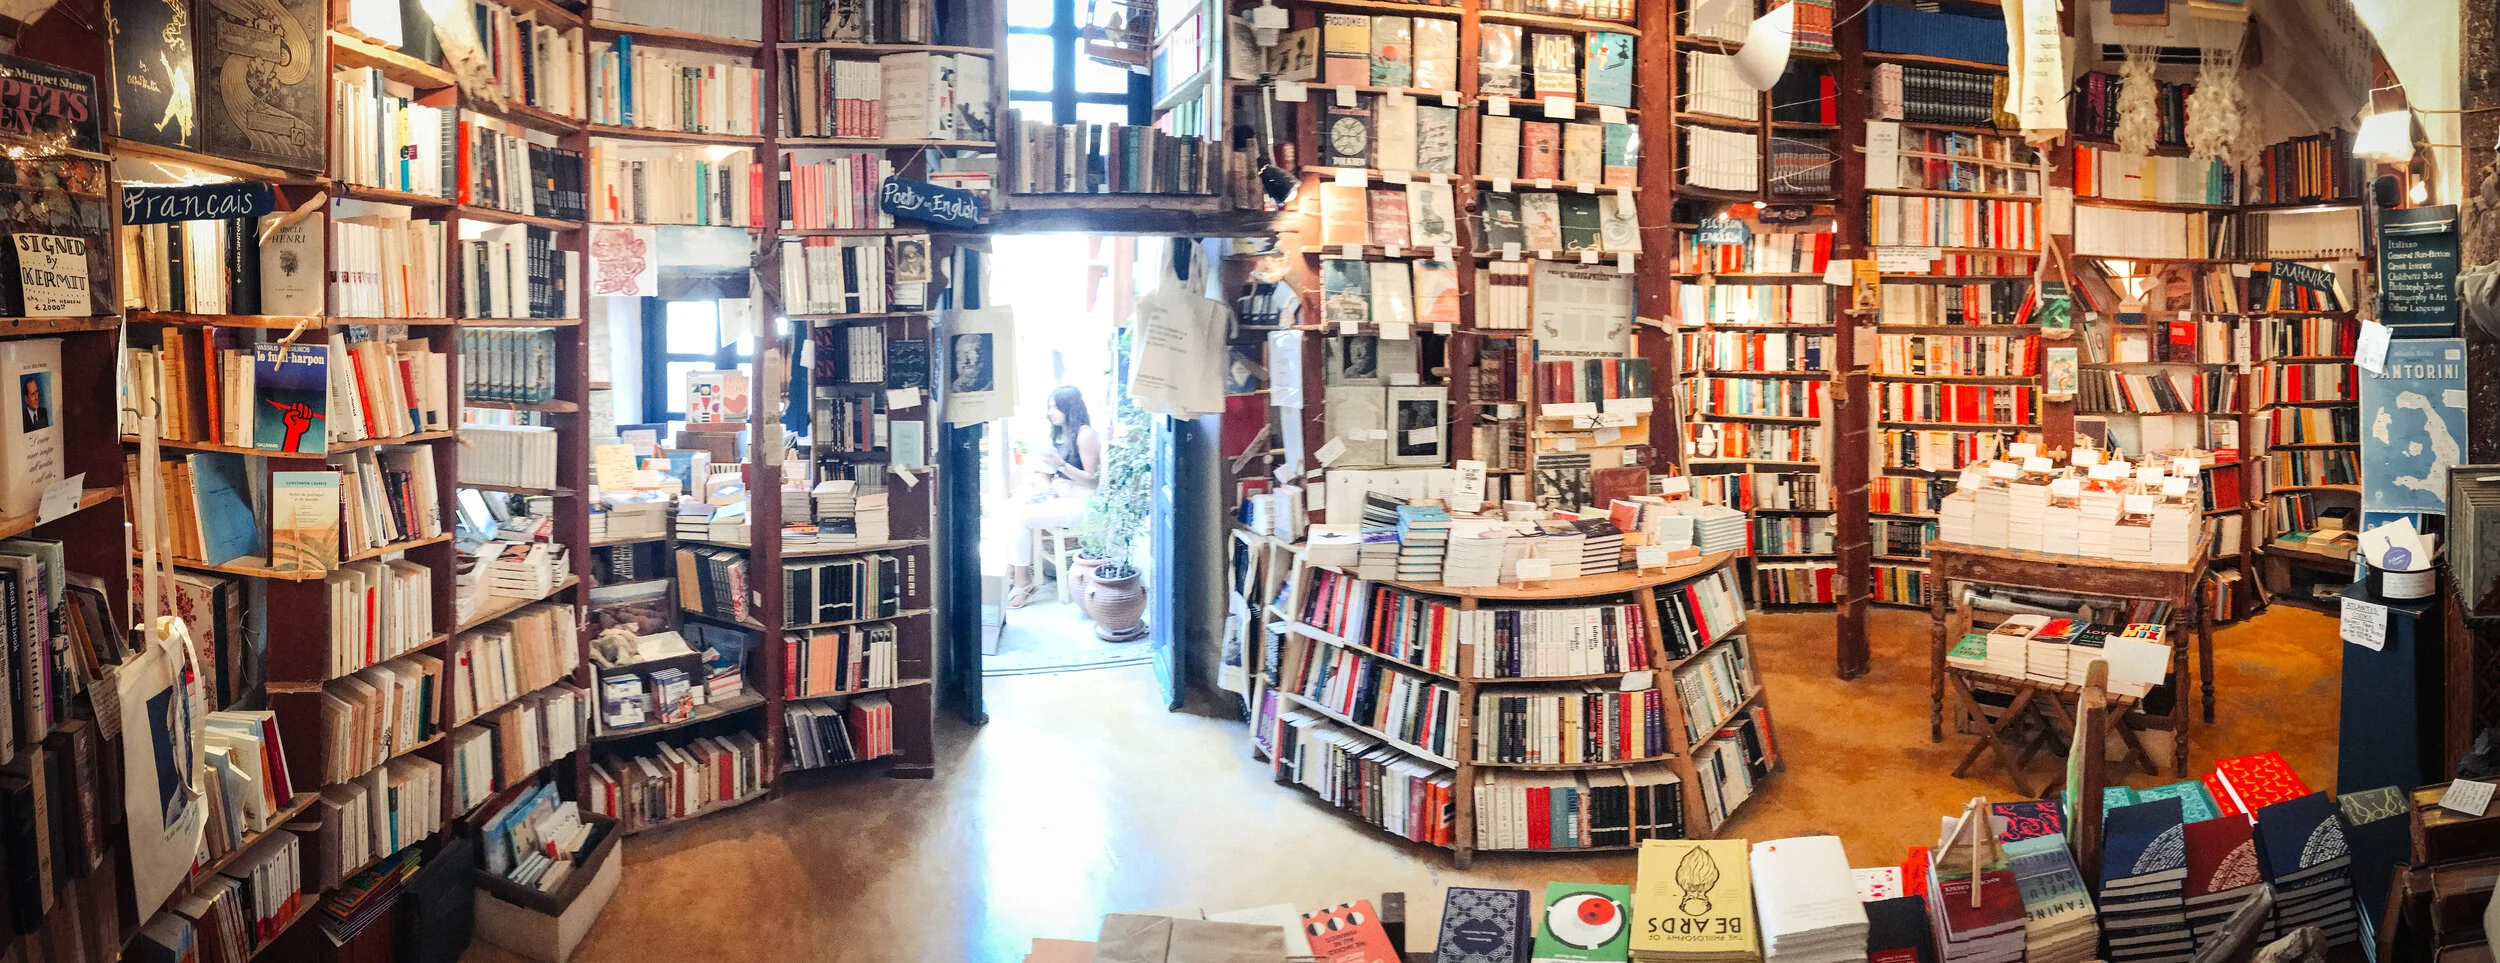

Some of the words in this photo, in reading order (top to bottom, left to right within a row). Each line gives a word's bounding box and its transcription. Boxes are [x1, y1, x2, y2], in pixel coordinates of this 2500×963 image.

[15, 67, 58, 86] Muppet
[60, 77, 88, 93] Show
[124, 188, 253, 224] Français
[932, 194, 980, 223] English
[19, 235, 87, 256] SIGNED
[2388, 240, 2418, 249] Italiano
[46, 254, 57, 270] By
[2388, 251, 2413, 260] General
[22, 266, 86, 291] KERMIT
[2423, 271, 2443, 280] Books
[2388, 282, 2424, 293] Philosophy
[2388, 292, 2428, 304] Photography
[2435, 293, 2448, 301] Art
[2388, 303, 2408, 311] Other
[2410, 304, 2445, 313] Languages
[256, 351, 266, 362] le
[2128, 624, 2162, 632] THE
[2025, 898, 2086, 922] FAMINE
[1647, 917, 1741, 934] BEARDS
